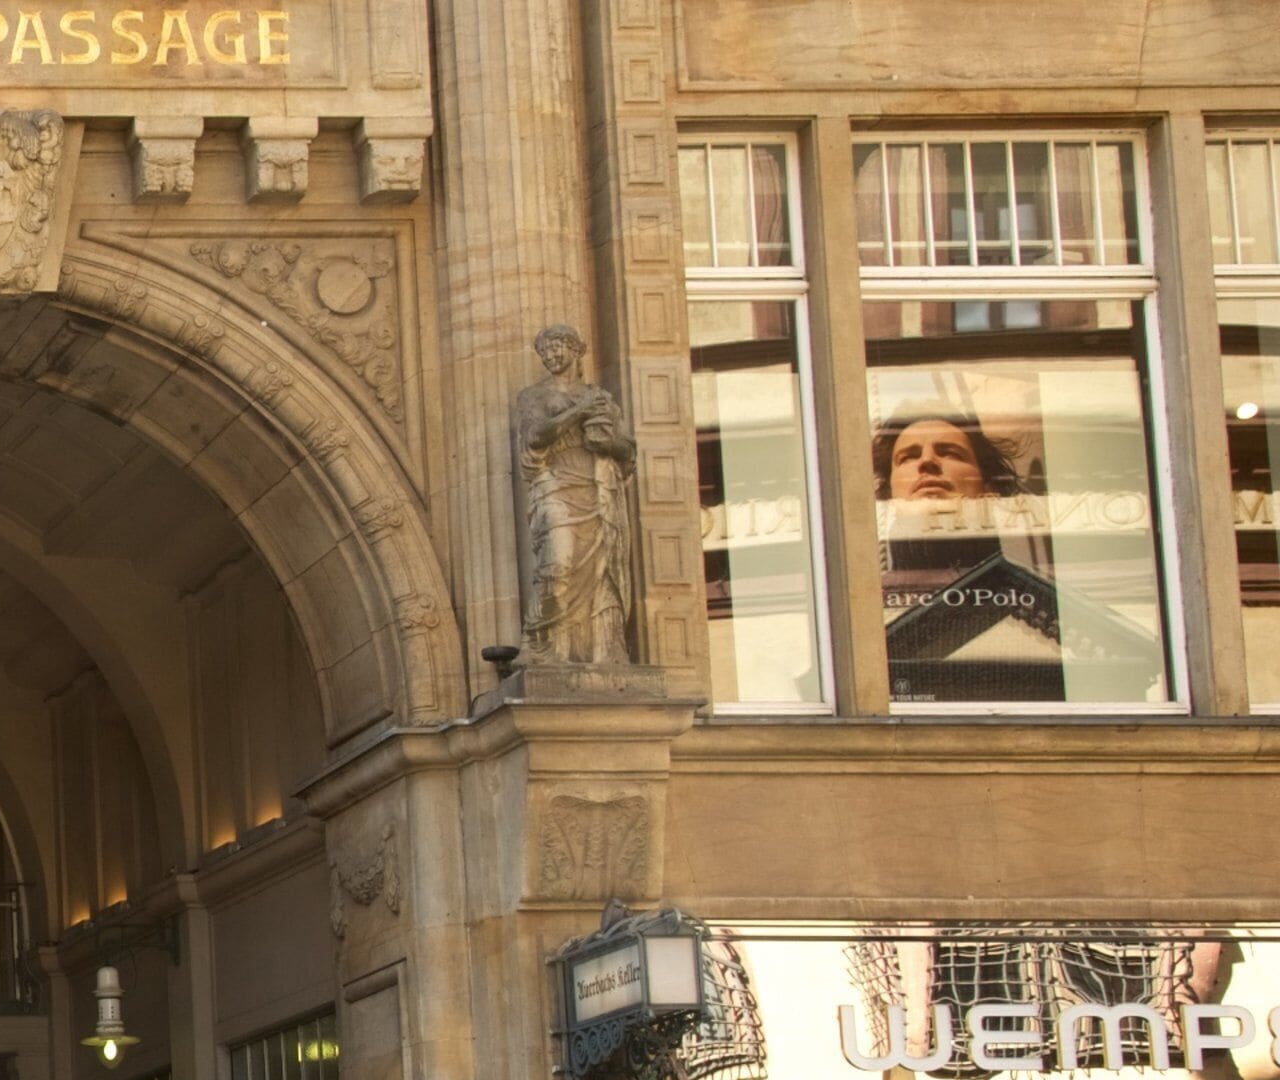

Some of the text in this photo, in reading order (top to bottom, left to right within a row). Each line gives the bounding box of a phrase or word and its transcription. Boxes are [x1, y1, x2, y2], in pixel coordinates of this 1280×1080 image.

[886, 588, 1036, 607] arc O'Polo
[838, 1002, 1280, 1072] WEMP
